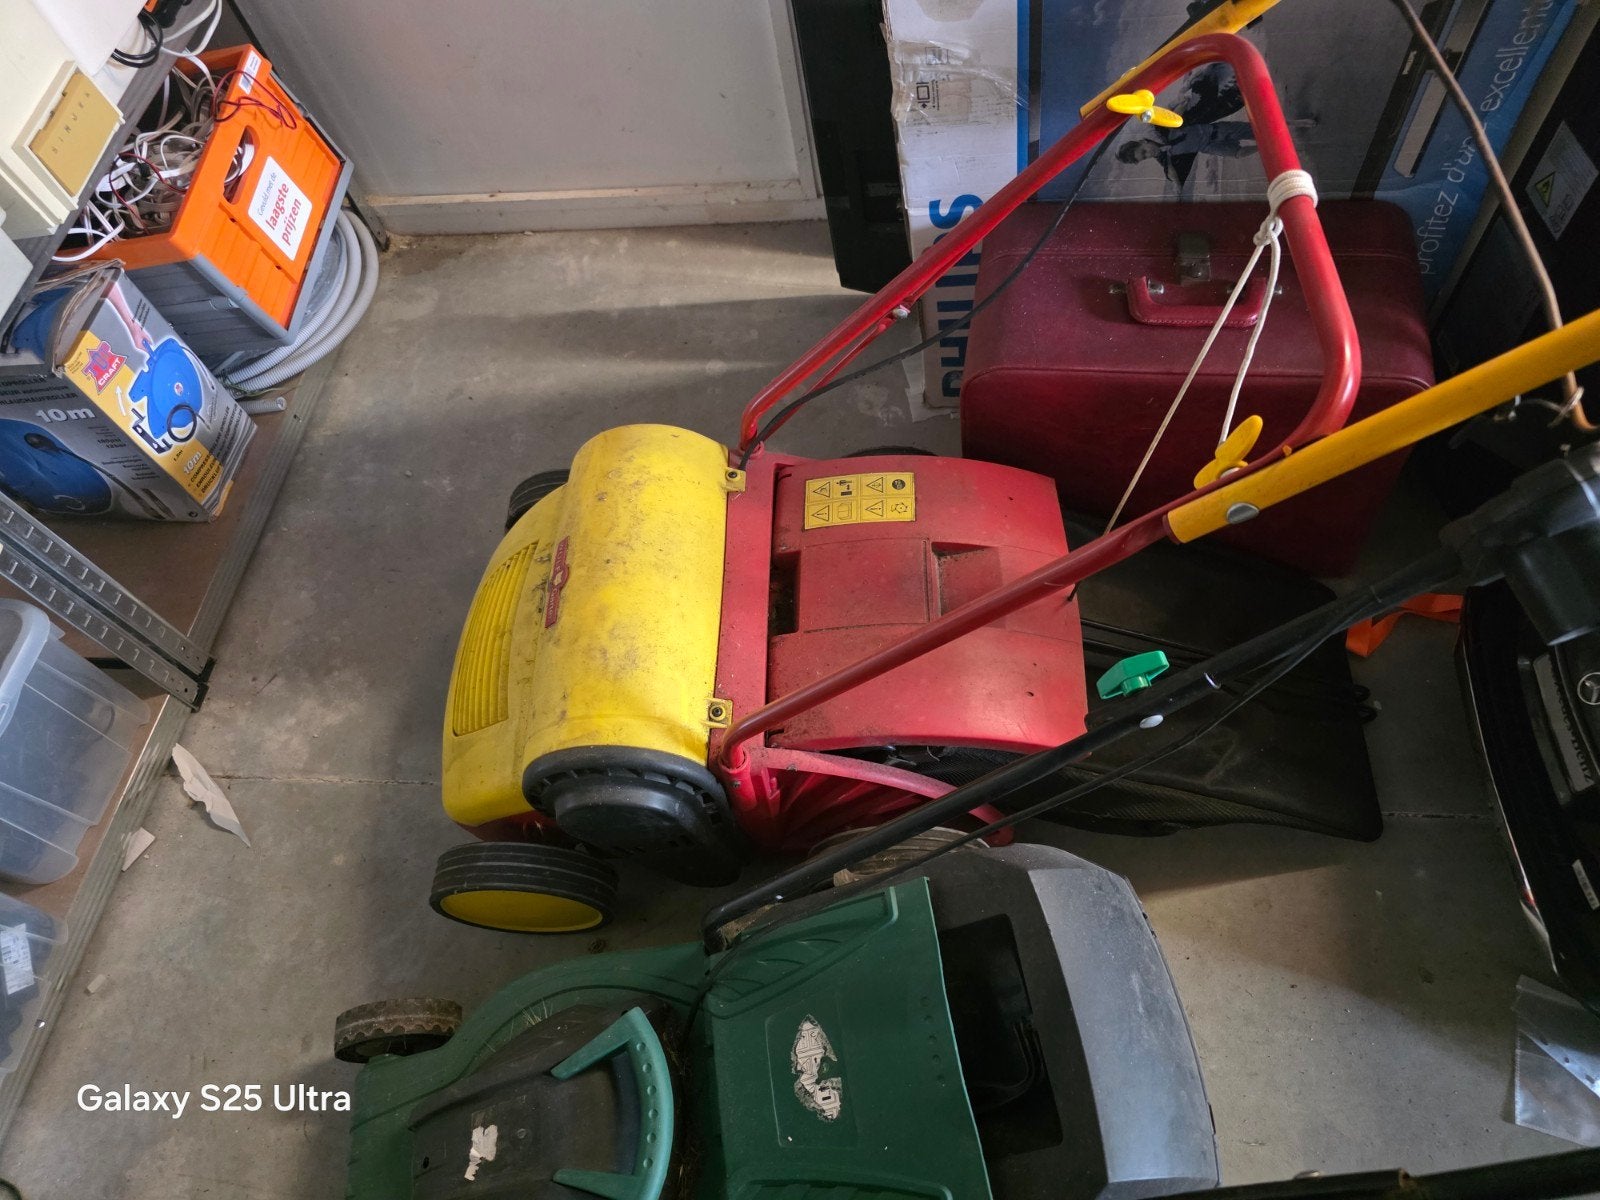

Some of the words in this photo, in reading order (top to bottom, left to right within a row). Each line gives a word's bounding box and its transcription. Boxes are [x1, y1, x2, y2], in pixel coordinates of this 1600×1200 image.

[265, 183, 289, 231] laagste
[281, 198, 302, 246] prijzen
[1417, 191, 1459, 275] profitez
[98, 357, 121, 386] CRAFT
[36, 407, 96, 423] 10m
[183, 451, 202, 474] 10m
